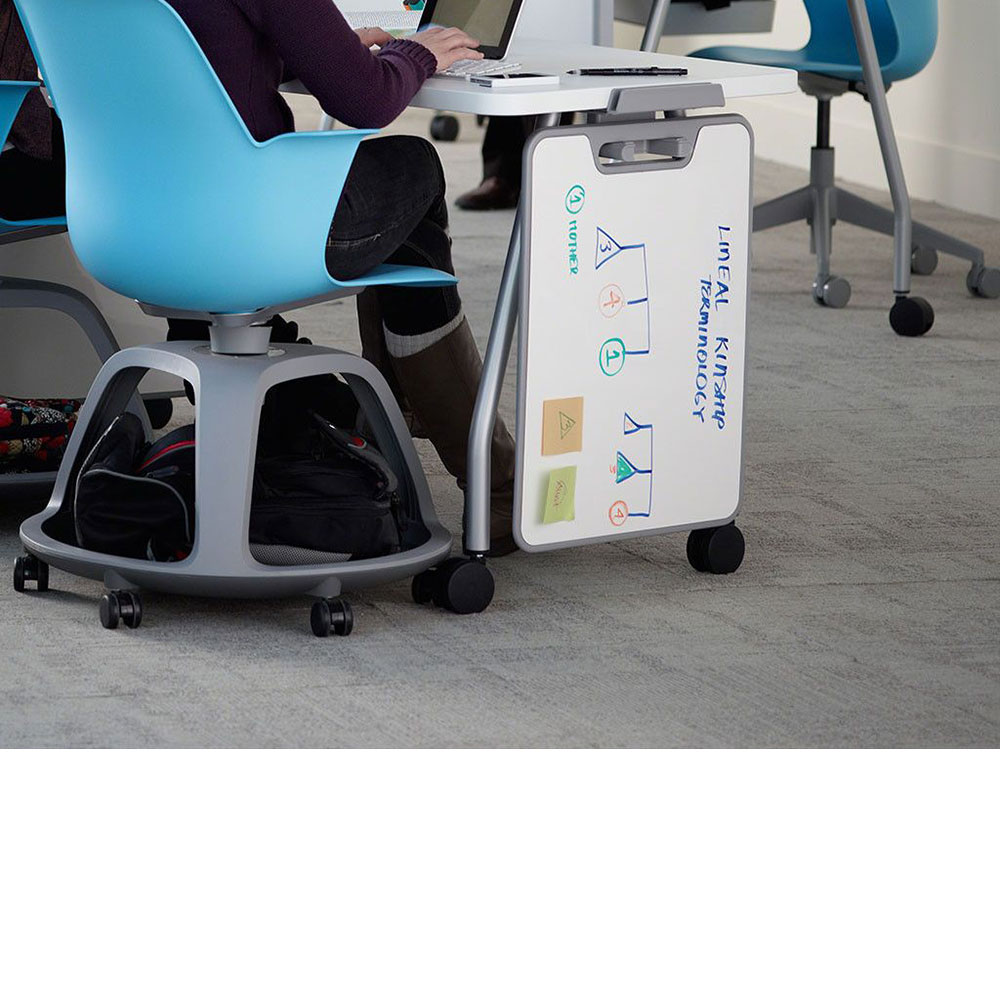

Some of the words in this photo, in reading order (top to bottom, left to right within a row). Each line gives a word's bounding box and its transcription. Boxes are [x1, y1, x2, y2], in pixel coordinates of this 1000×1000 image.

[568, 219, 579, 276] MOTHER
[715, 225, 731, 311] LINEAL
[692, 274, 712, 423] TERMINOLOGY
